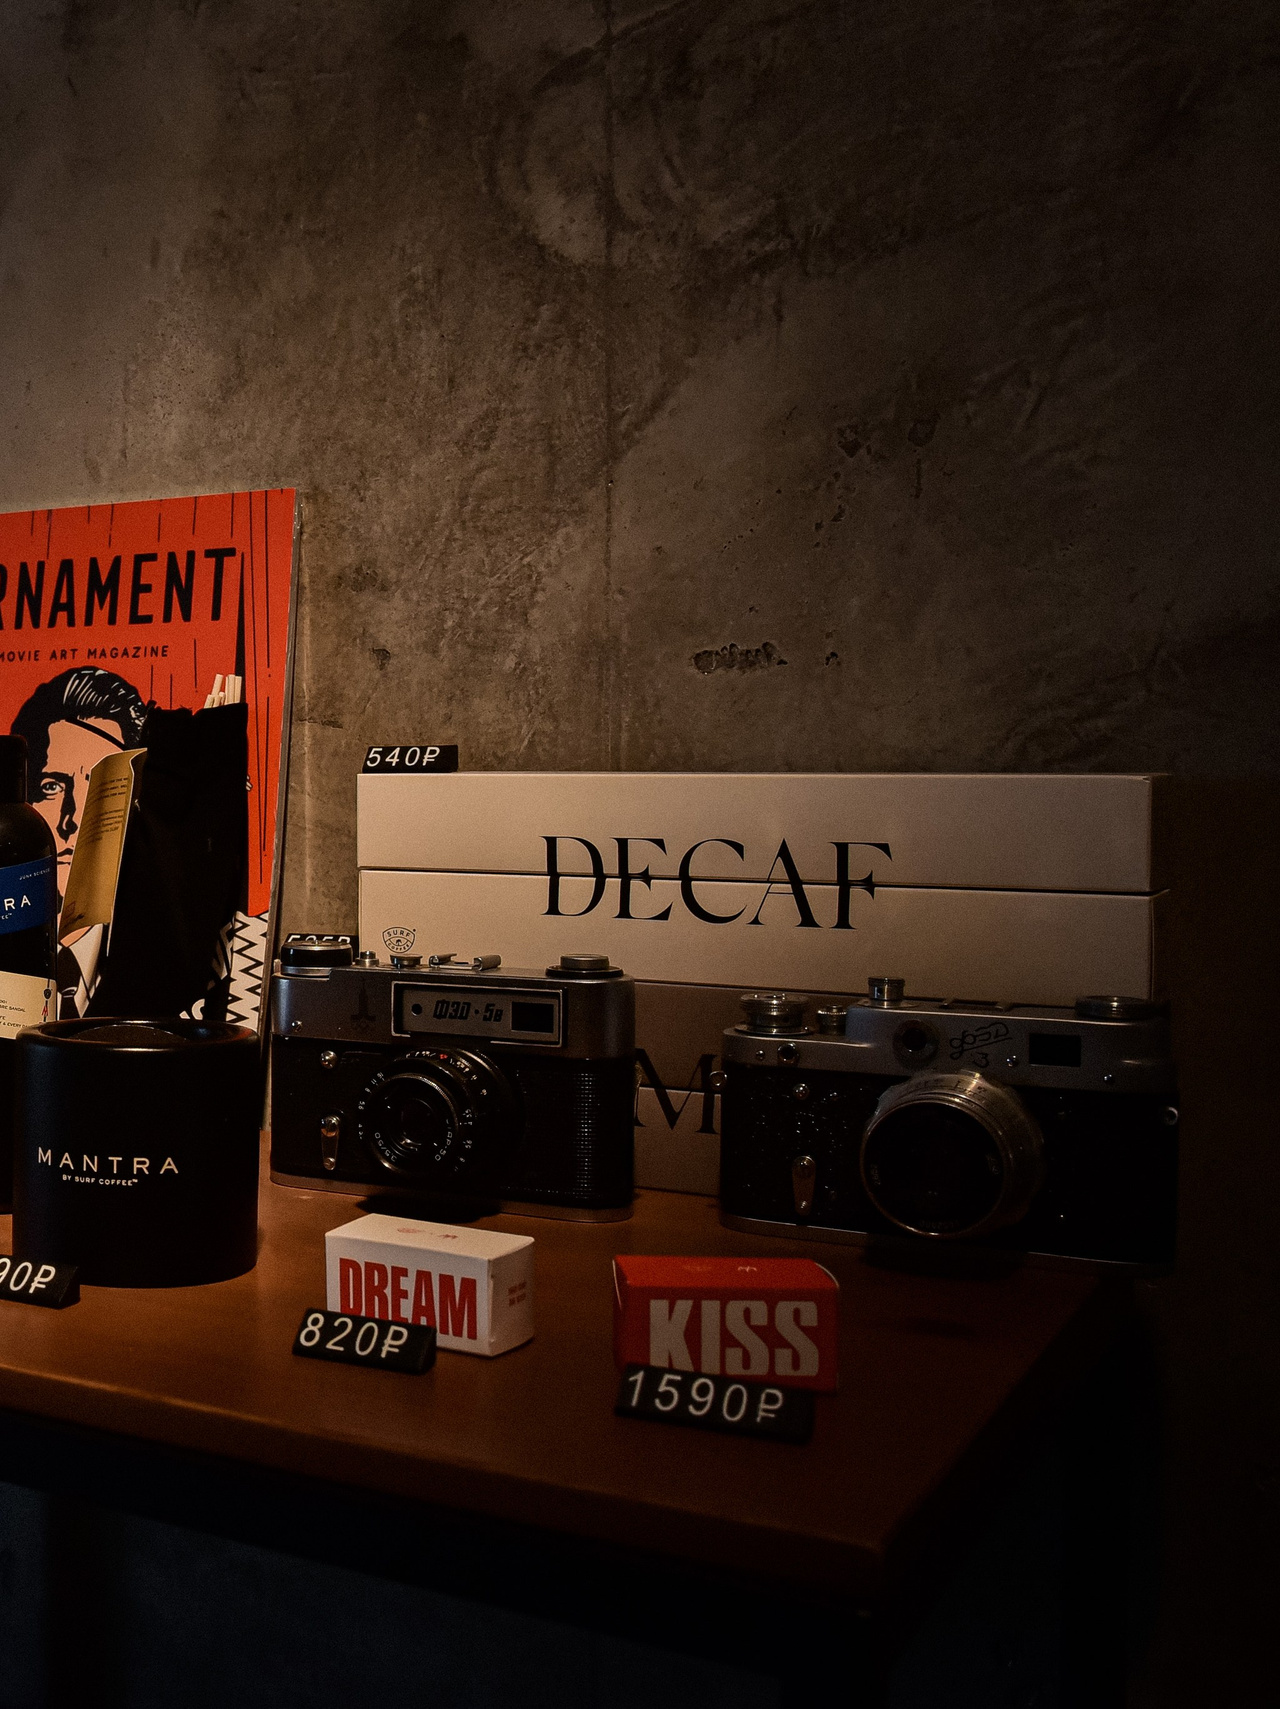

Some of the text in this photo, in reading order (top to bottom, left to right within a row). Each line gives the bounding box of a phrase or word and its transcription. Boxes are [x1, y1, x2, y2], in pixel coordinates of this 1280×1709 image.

[49, 647, 79, 661] ART
[87, 645, 169, 660] MAGAZINE
[540, 836, 892, 930] DECAF
[386, 928, 411, 938] SURF
[37, 1146, 180, 1175] MANTRA
[61, 1173, 72, 1181] BY
[74, 1175, 96, 1184] SURF
[338, 1257, 478, 1341] DREAM
[649, 1298, 819, 1377] KISS
